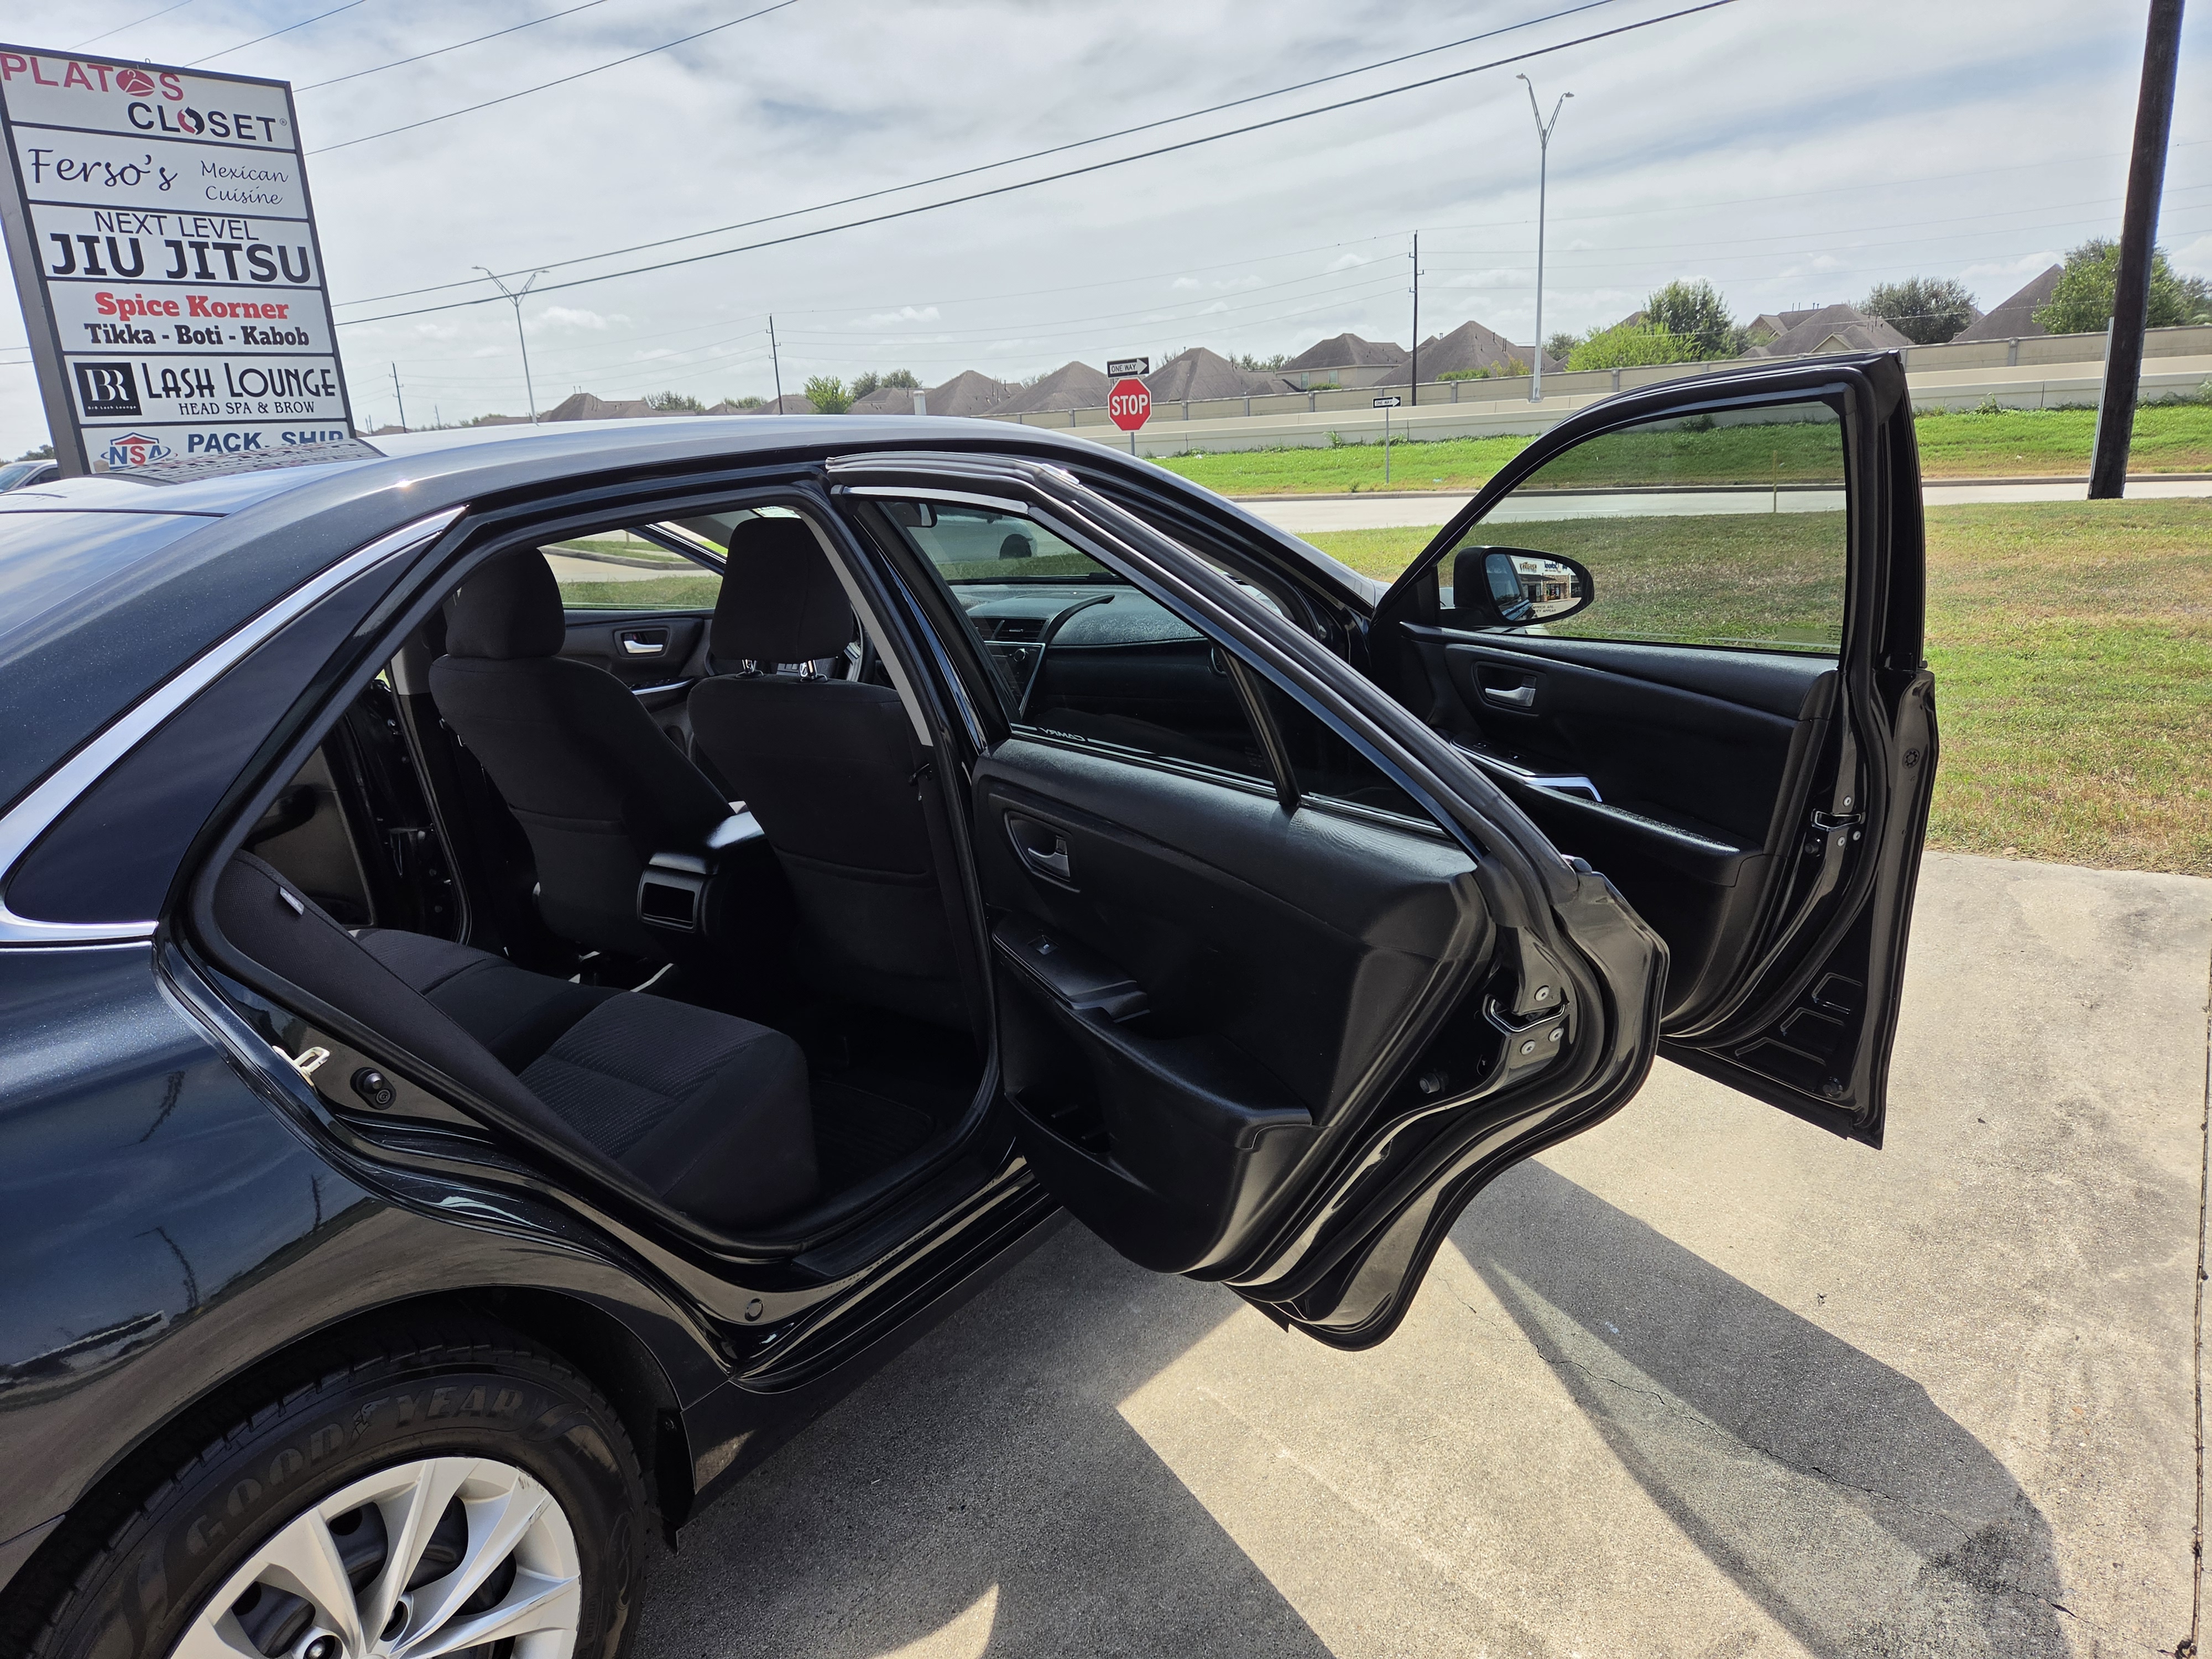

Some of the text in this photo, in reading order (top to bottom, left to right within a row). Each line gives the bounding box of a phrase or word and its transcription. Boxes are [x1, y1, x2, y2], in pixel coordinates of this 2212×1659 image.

[127, 102, 275, 142] CLOSET
[28, 148, 178, 191] Ferso's
[201, 160, 289, 184] Mexican
[205, 185, 284, 205] Cuisine
[94, 211, 259, 241] NEXT LEVEL
[50, 233, 312, 284] JIU JITSU
[94, 291, 289, 322] Spice Korner
[84, 322, 156, 346] Tikka
[174, 325, 225, 346] Boti
[240, 325, 310, 347] Kabob
[141, 362, 336, 399] LASH LOUNGE
[1111, 364, 1123, 373] ONE
[179, 401, 315, 416] HEAD SPA & BROW
[1111, 394, 1149, 416] STOP
